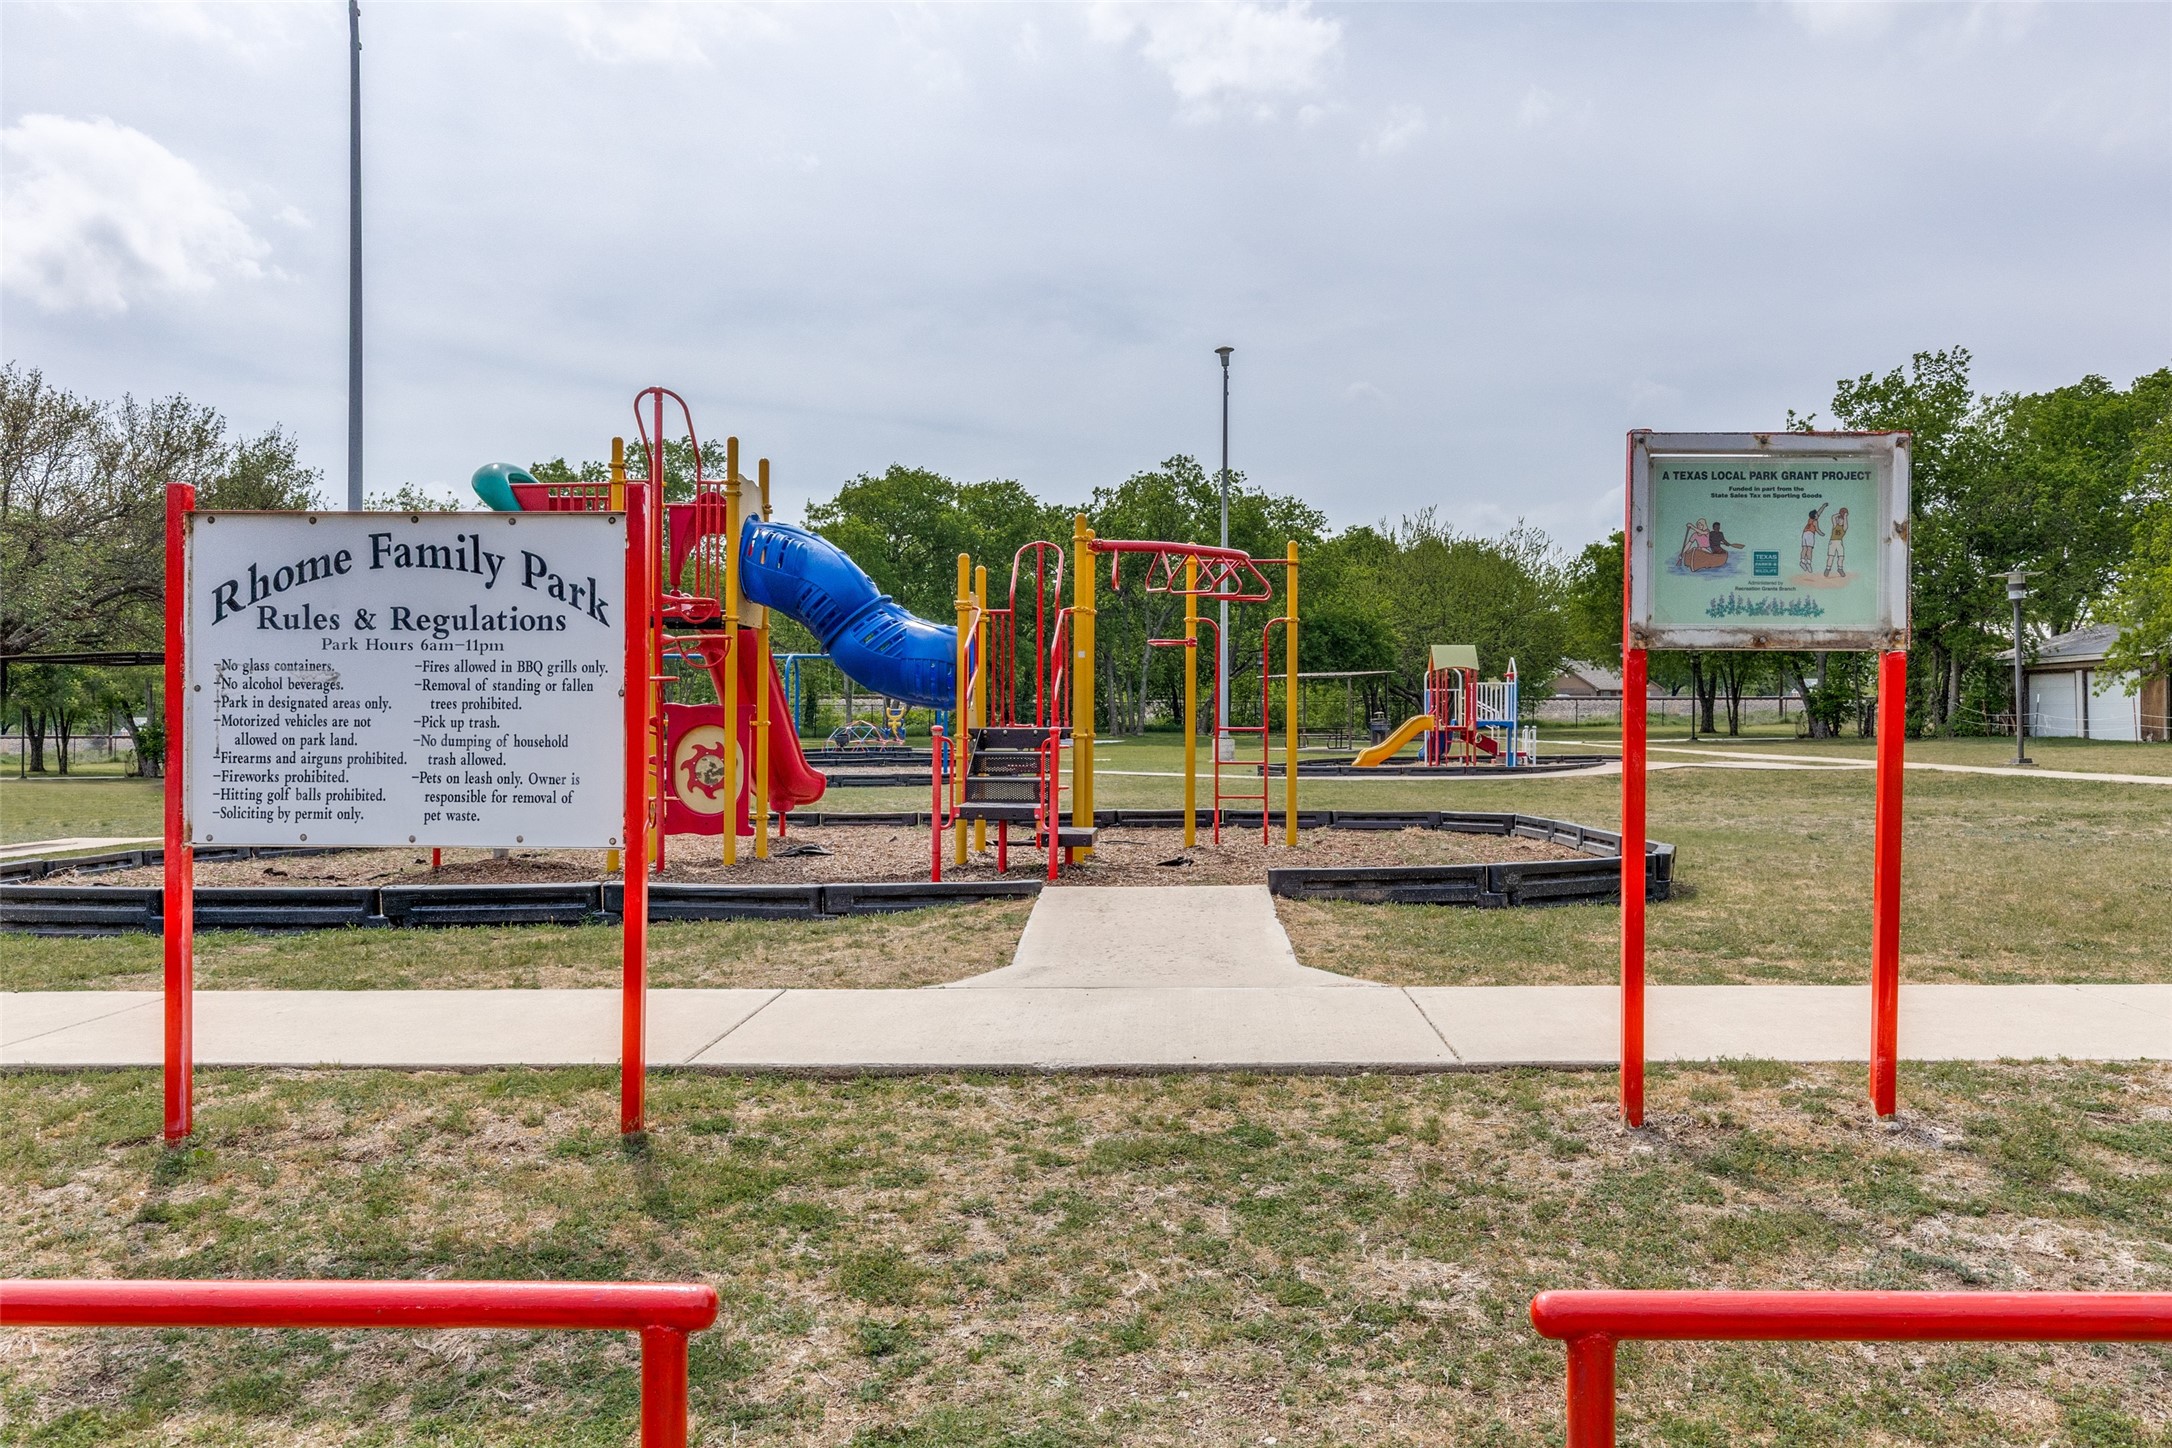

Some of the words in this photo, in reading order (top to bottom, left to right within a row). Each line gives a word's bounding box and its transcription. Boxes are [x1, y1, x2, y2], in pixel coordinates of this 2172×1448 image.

[1662, 471, 1670, 480] A
[1673, 471, 1708, 480] TEXAS
[1711, 471, 1746, 480] LOCAL
[1749, 471, 1778, 480] PARK
[1781, 471, 1819, 480] GRANT
[1822, 471, 1872, 480] PROJECT
[212, 549, 352, 626] Rhome
[369, 532, 505, 589] Family
[521, 550, 610, 628] Park
[257, 603, 340, 631] Rules
[354, 608, 376, 631] &
[390, 604, 566, 640] Regulations
[321, 637, 359, 651] Park
[365, 638, 414, 651] Hours
[242, 658, 269, 675] glass
[274, 660, 335, 671] containers.
[454, 660, 496, 673] allowed
[501, 660, 512, 673] in
[517, 661, 543, 677] BBQ
[547, 660, 577, 677] grills
[582, 660, 608, 677] only.
[243, 677, 282, 690] alcohol
[288, 677, 344, 694] beverages.
[475, 678, 488, 691] of
[492, 679, 541, 695] standing
[545, 682, 557, 691] or
[562, 678, 594, 691] fallen
[253, 696, 264, 708] in
[268, 696, 328, 712] designated
[333, 700, 360, 709] areas
[365, 696, 392, 713] only.
[431, 700, 457, 709] trees
[462, 697, 522, 713] prohibited.
[285, 714, 327, 727] vehicles
[332, 719, 349, 727] are
[354, 717, 371, 727] not
[450, 720, 464, 732] up
[469, 716, 500, 728] trash.
[235, 732, 277, 745] allowed
[282, 737, 295, 745] on
[300, 733, 325, 749] park
[330, 733, 358, 746] land.
[441, 734, 491, 751] dumping
[496, 734, 509, 747] of
[514, 734, 568, 748] household
[276, 751, 296, 764] and
[301, 752, 342, 768] airguns
[347, 751, 407, 768] prohibited.
[428, 752, 456, 765] trash
[460, 753, 506, 766] allowed.
[284, 770, 349, 786] prohibited.
[446, 775, 460, 784] on
[465, 771, 492, 784] leash
[497, 771, 523, 788] only.
[528, 772, 566, 785] Owner
[571, 773, 580, 785] is
[267, 787, 291, 804] golf
[296, 787, 321, 801] balls
[326, 788, 386, 805] prohibited.
[425, 790, 486, 806] responsible
[491, 789, 508, 803] for
[512, 790, 557, 803] removal
[561, 790, 574, 804] of
[278, 806, 291, 822] by
[295, 807, 332, 823] permit
[337, 807, 364, 823] only.
[424, 811, 441, 825] pet
[446, 811, 480, 822] waste.
